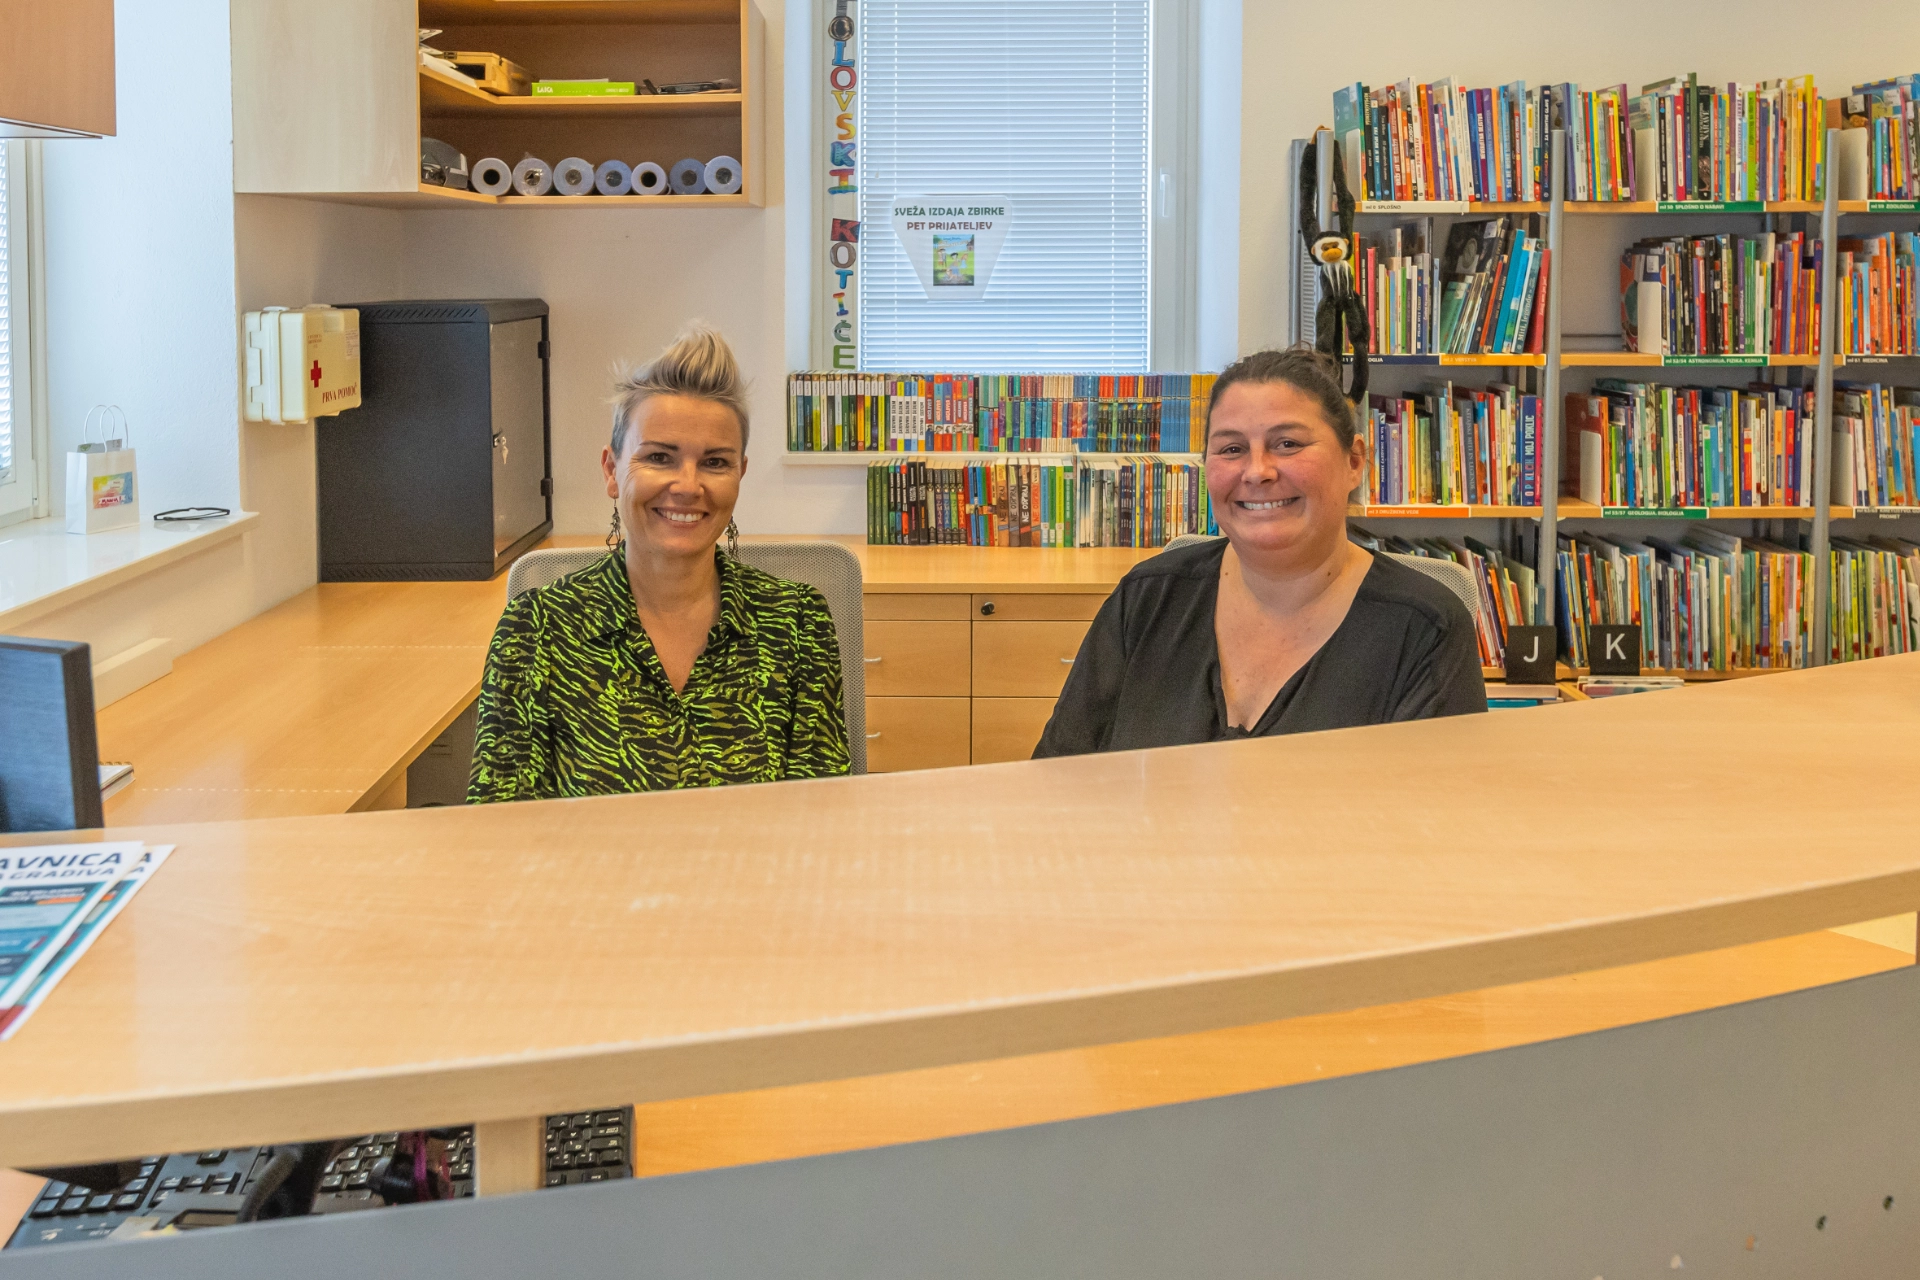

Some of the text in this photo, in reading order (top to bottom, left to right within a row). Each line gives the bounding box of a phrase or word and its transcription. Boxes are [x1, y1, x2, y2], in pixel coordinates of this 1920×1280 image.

[895, 206, 1004, 216] SVEŽA IZDAJA ZBIRKE
[907, 222, 992, 230] PET PRIJATELJEV
[1521, 294, 1532, 322] legende
[322, 390, 336, 403] PRVA
[1524, 415, 1534, 439] POKLIC
[1525, 441, 1534, 455] MOJ
[1000, 511, 1006, 522] NE
[1011, 512, 1017, 521] NE
[1022, 511, 1029, 522] NE
[1033, 511, 1039, 521] NE
[1523, 636, 1539, 662] J
[1606, 633, 1626, 660] K
